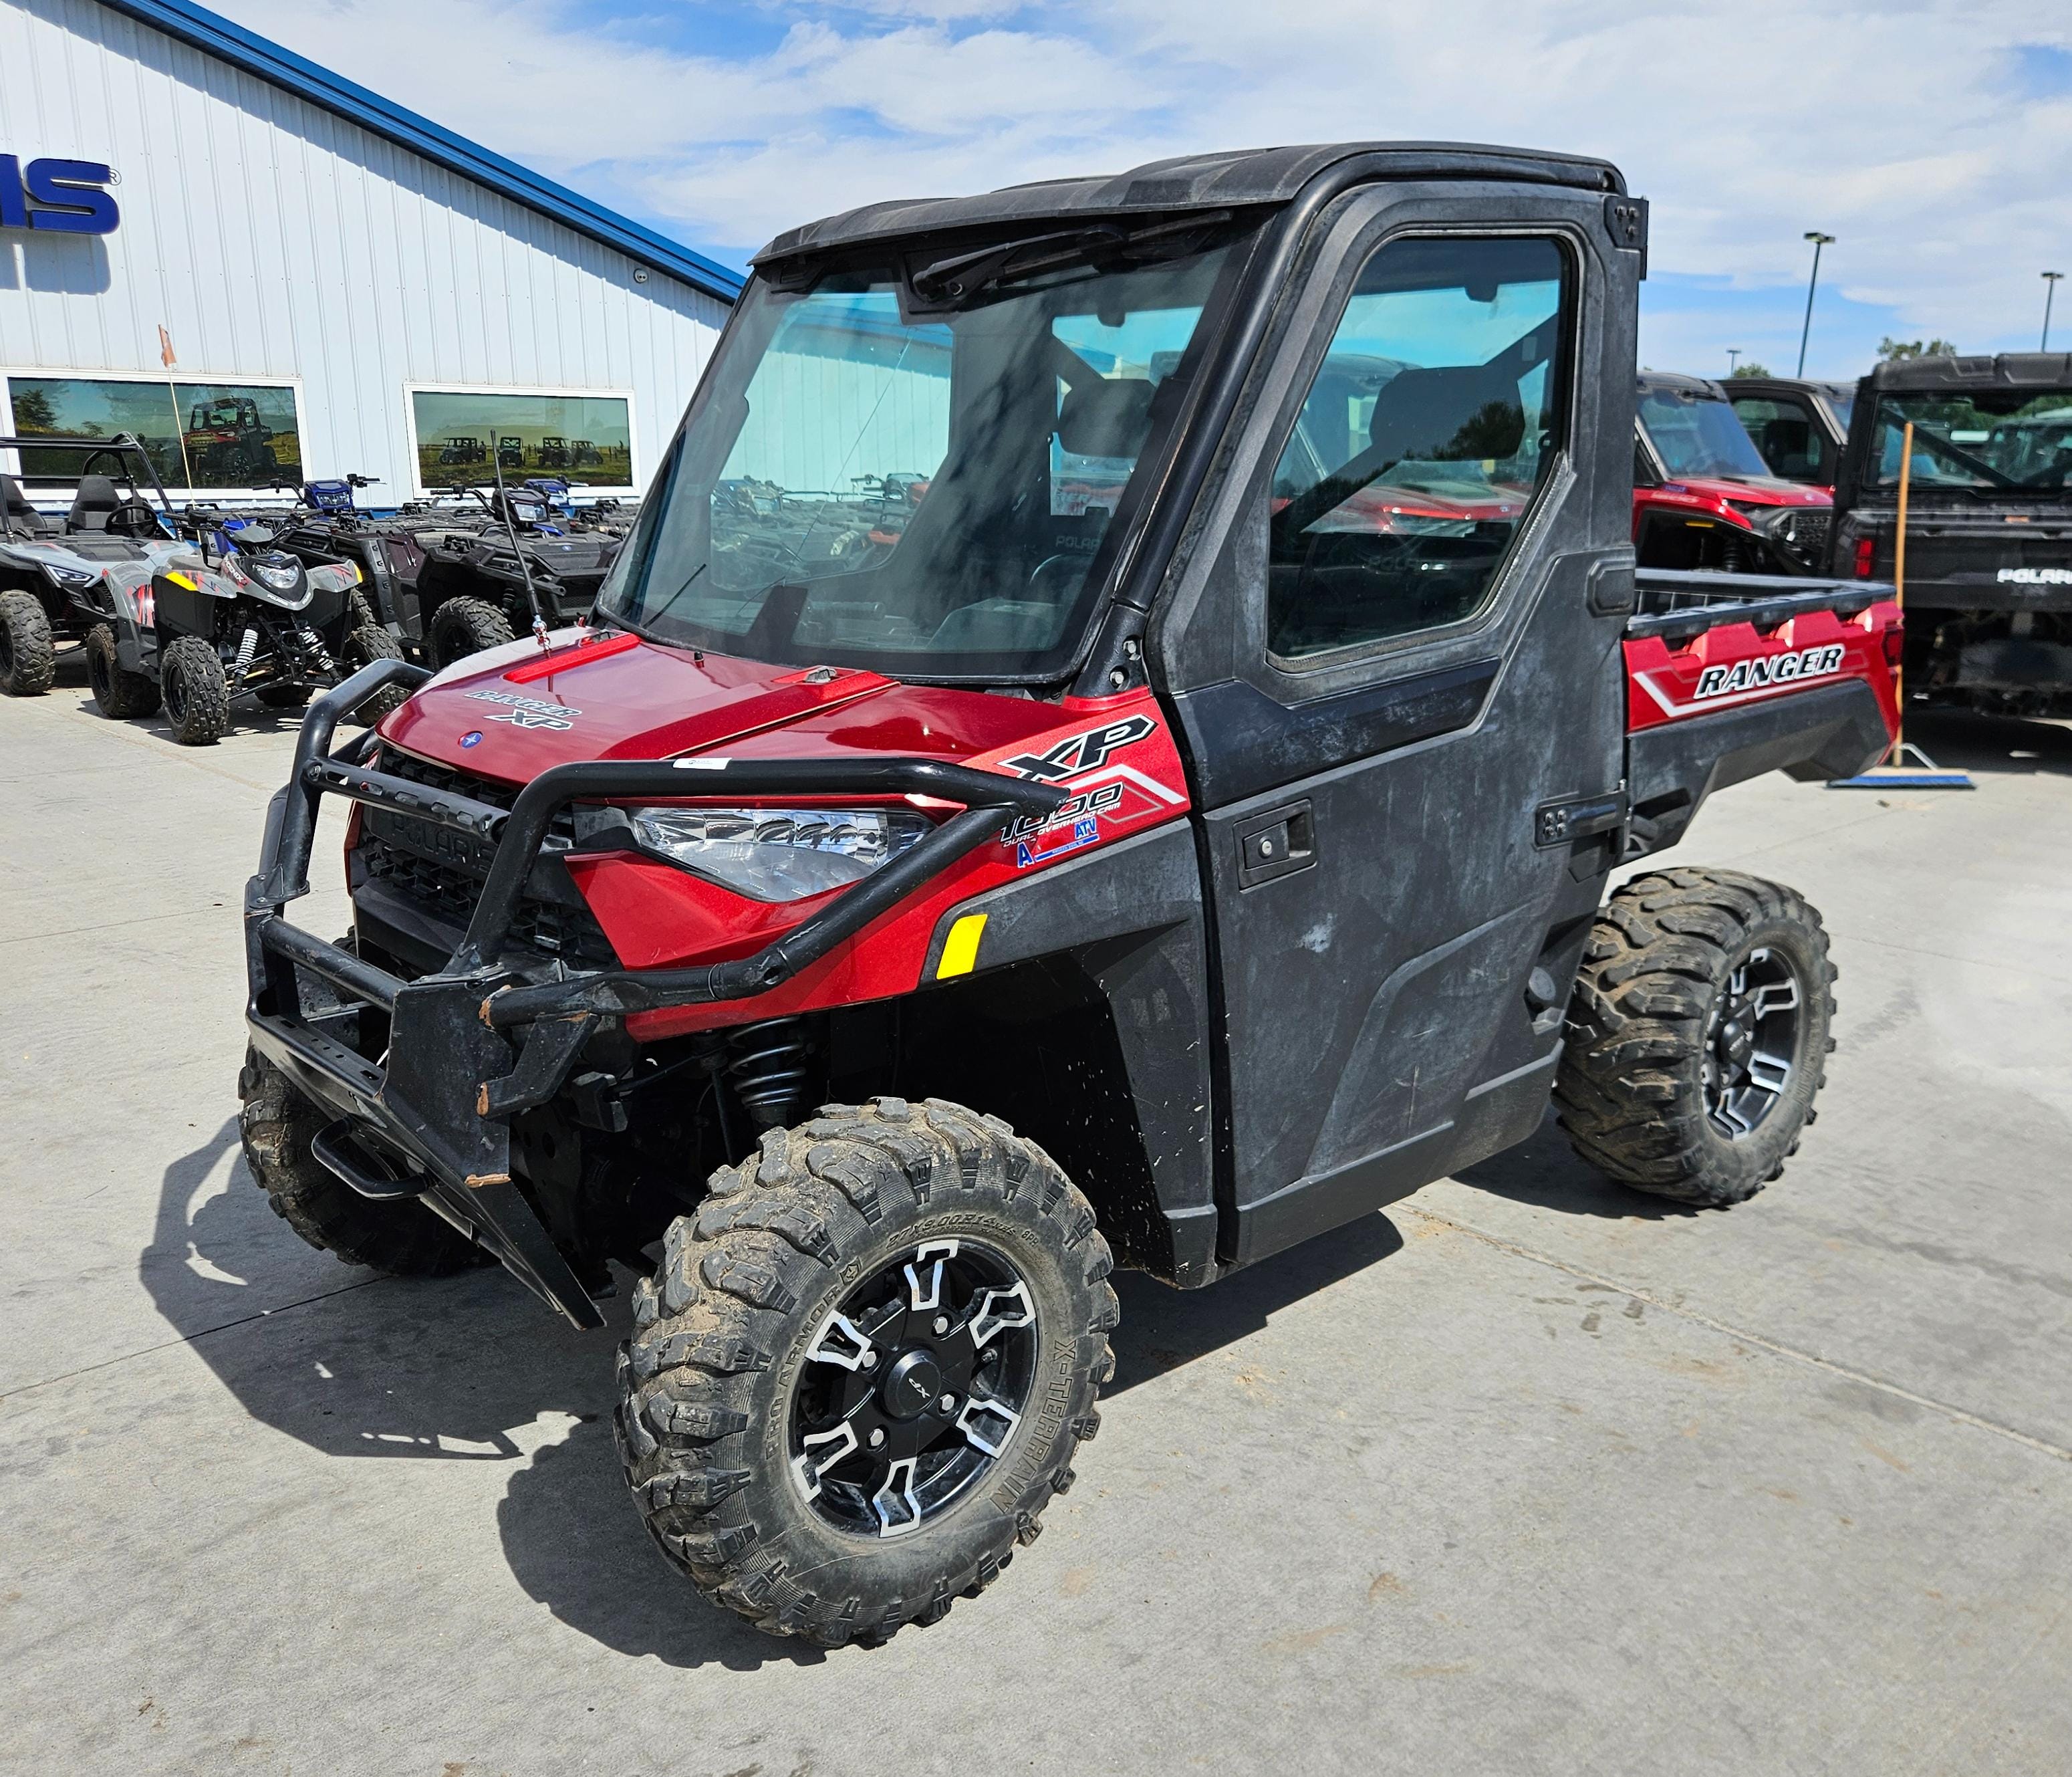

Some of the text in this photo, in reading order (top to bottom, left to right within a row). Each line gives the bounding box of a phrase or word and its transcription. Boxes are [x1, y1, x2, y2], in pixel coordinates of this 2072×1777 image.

[1693, 643, 1845, 700] RANGER
[464, 690, 582, 718] RANGER
[483, 709, 573, 730] XP
[995, 713, 1158, 782] XP
[1003, 834, 1034, 848] DUAL
[1037, 810, 1097, 837] OVERHEAD
[1095, 801, 1120, 816] CAM
[1074, 817, 1097, 840] ATV
[1017, 841, 1035, 868] A
[908, 1377, 931, 1399] XP
[989, 1339, 1077, 1514] X-TERRAIN
